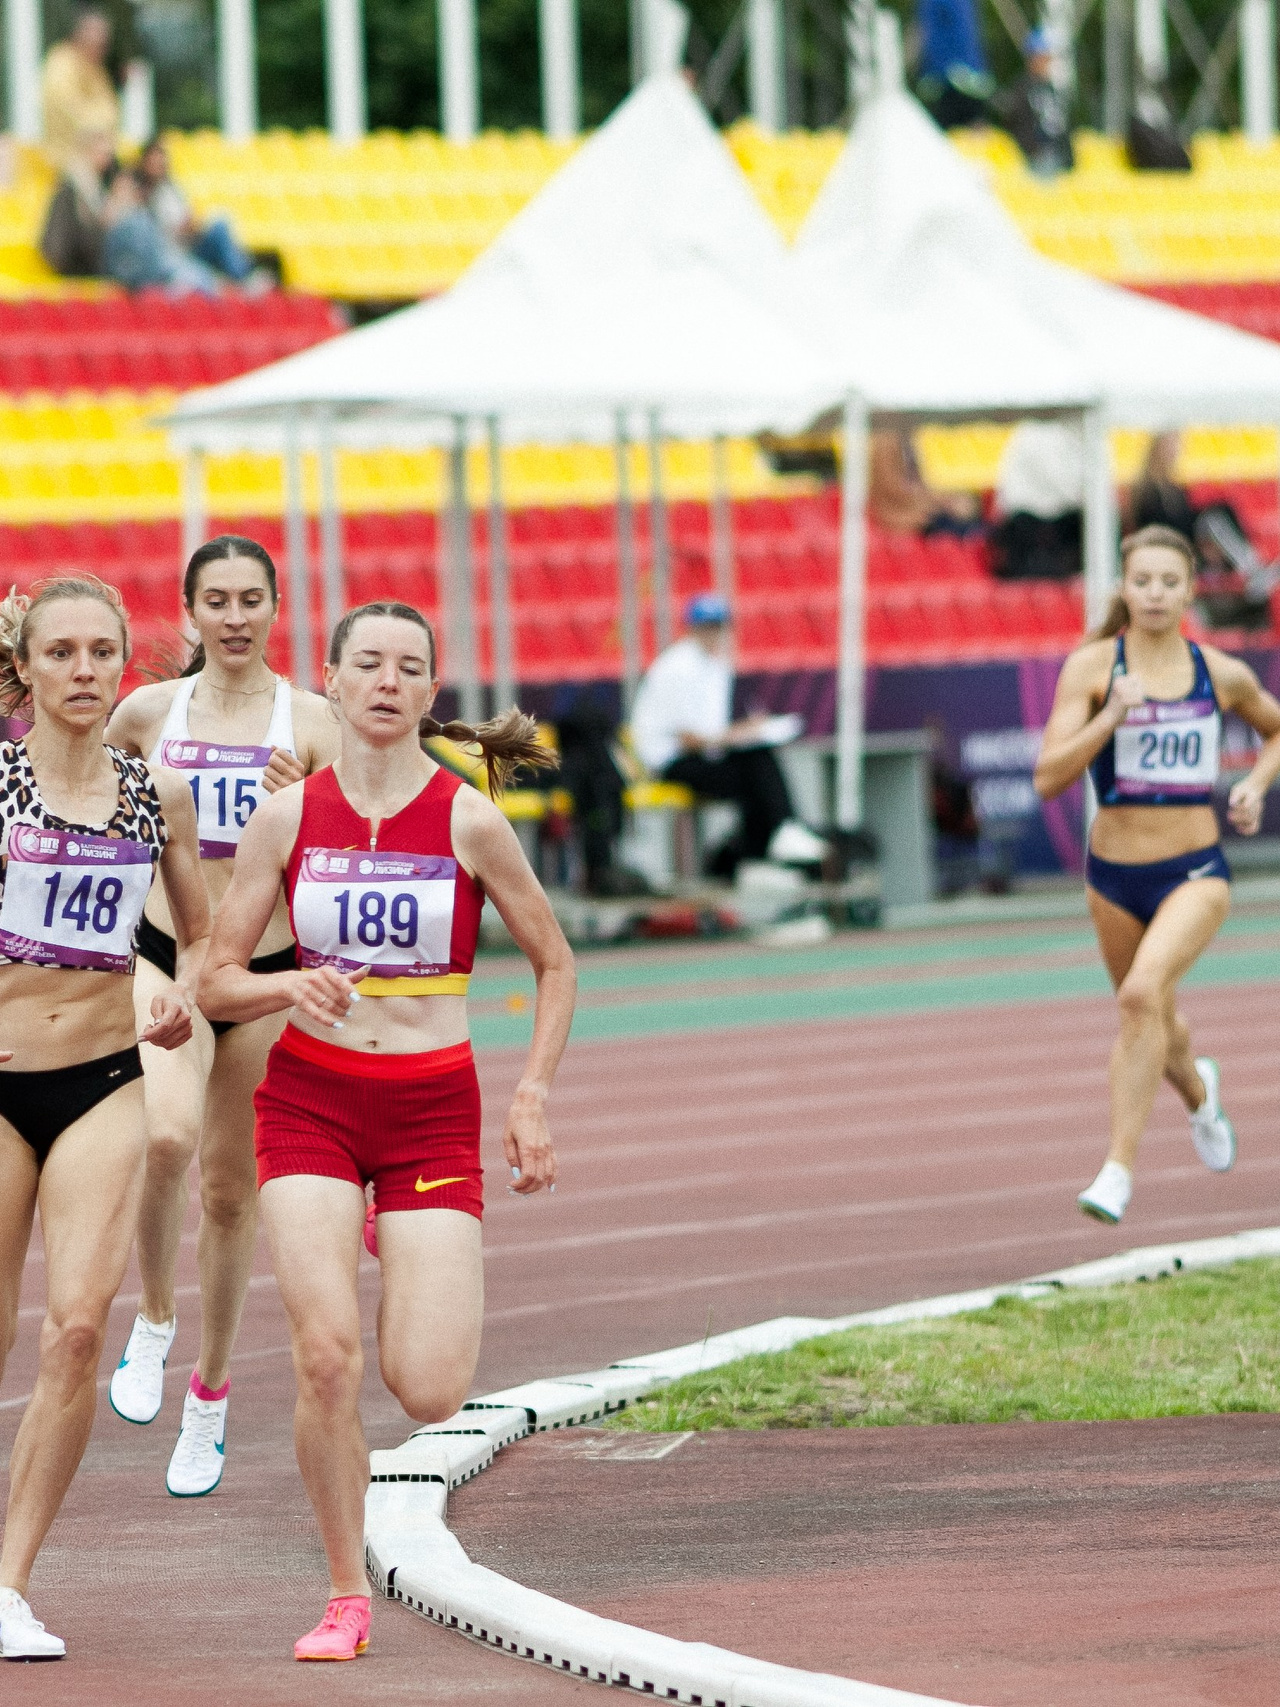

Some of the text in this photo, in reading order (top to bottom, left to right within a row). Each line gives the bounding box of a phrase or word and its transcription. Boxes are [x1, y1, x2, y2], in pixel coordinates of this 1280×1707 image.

[218, 755, 254, 764] ЛИЗИНГ
[1139, 730, 1202, 770] 200
[80, 850, 118, 860] ЛИЗИНГ
[43, 872, 123, 934] 148
[334, 889, 419, 949] 189
